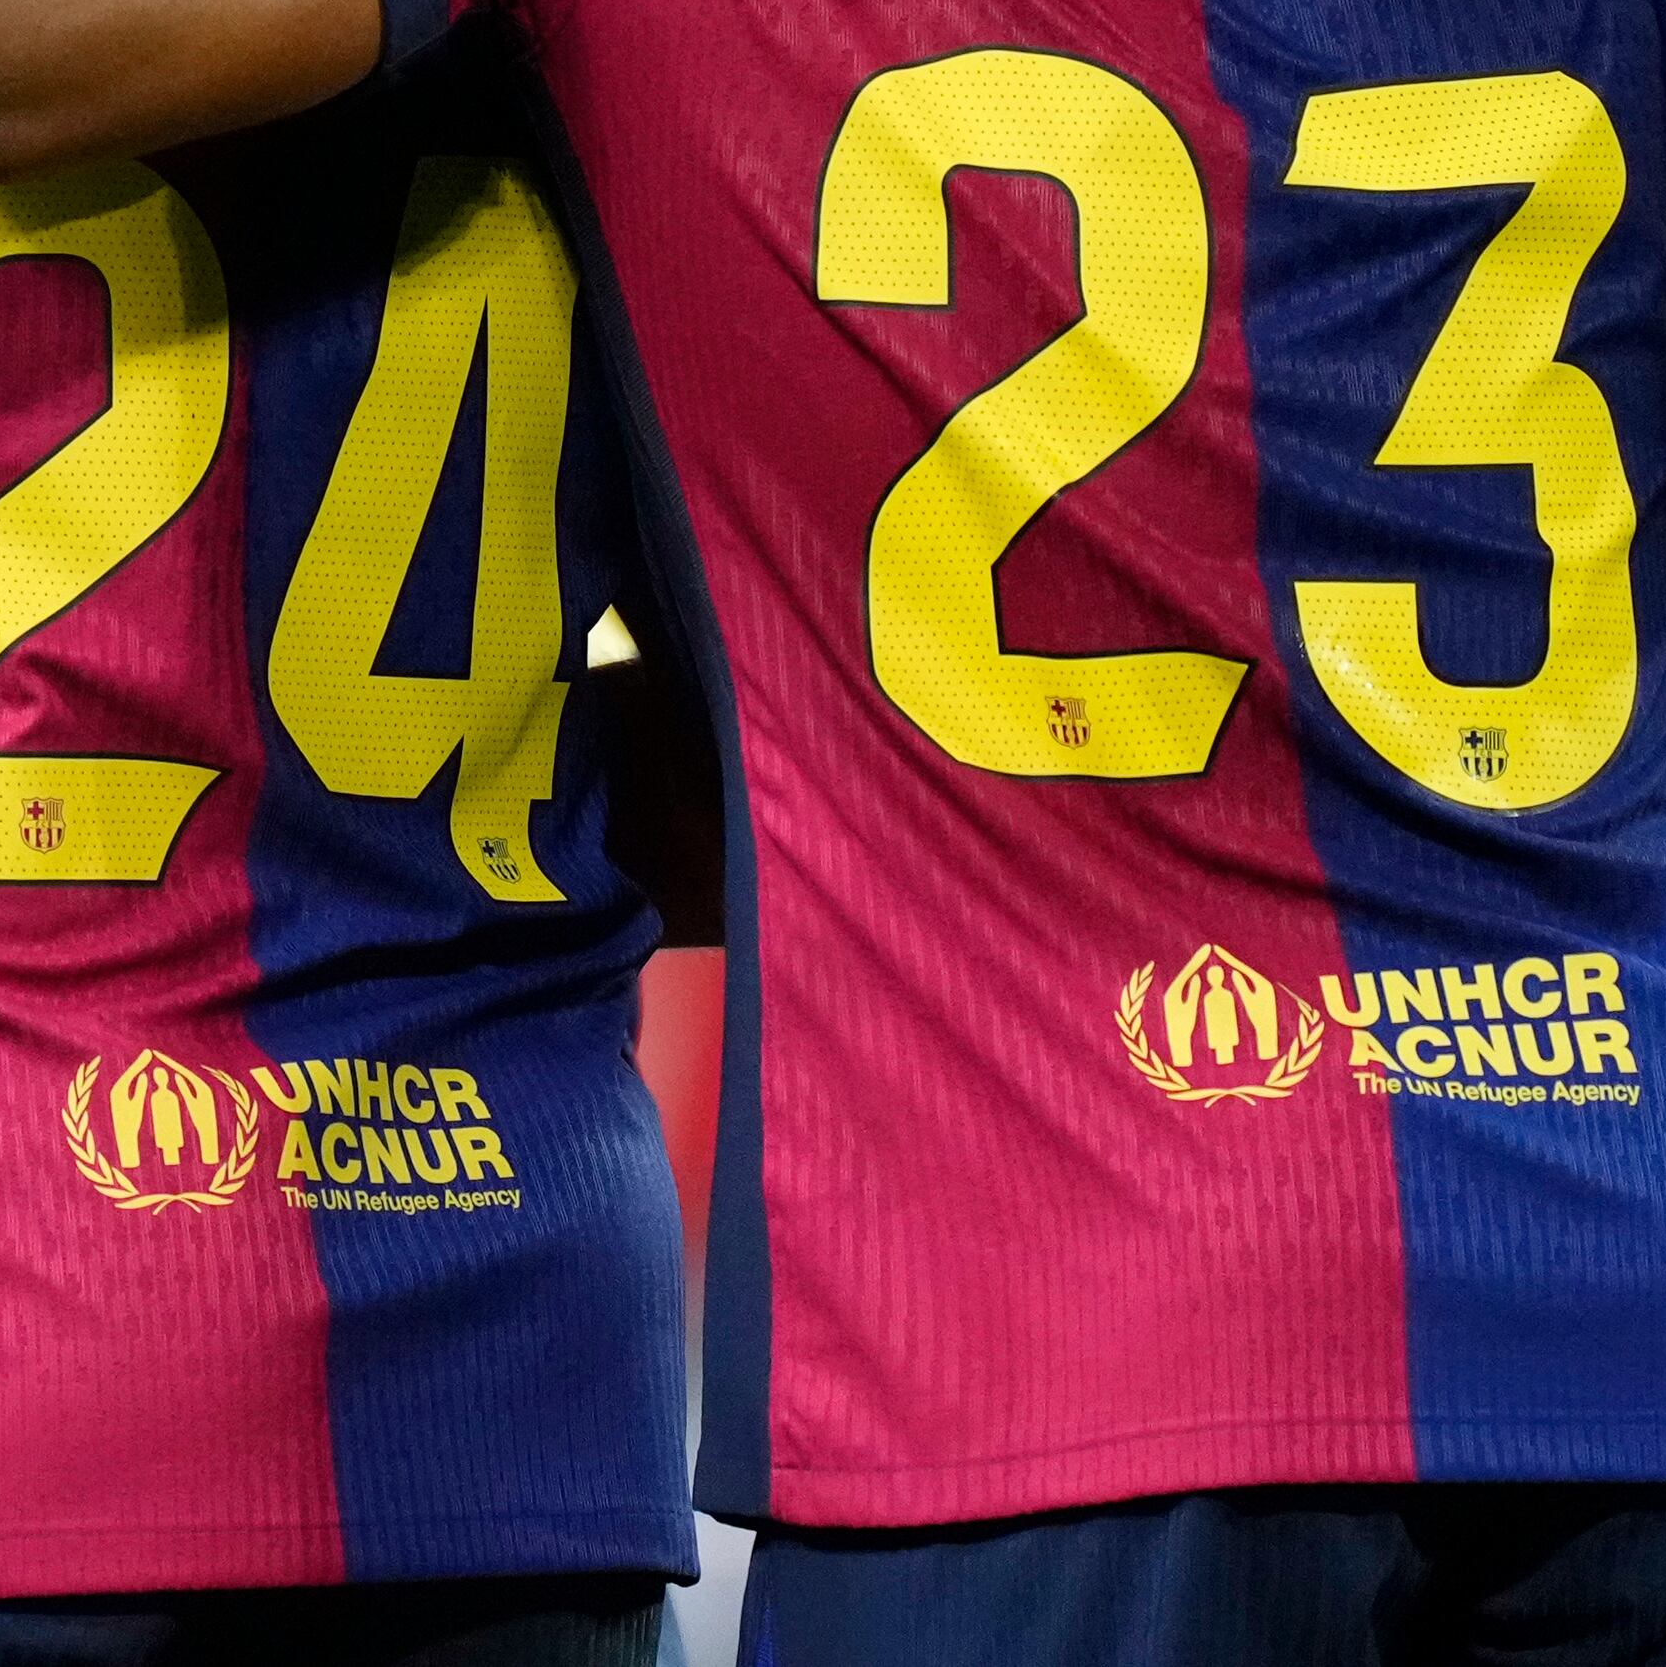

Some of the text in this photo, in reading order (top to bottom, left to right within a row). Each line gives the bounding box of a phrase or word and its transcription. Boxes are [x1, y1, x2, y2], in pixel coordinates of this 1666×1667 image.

[816, 49, 1638, 811] 23
[1319, 952, 1625, 1028] UNHCR
[1348, 1019, 1637, 1077] ACNUR
[249, 1058, 492, 1124] UNHCR
[1352, 1072, 1641, 1107] The UN Refugee Agency
[276, 1121, 515, 1185] ACNUR
[280, 1186, 522, 1216] The UN Refugee Agency
